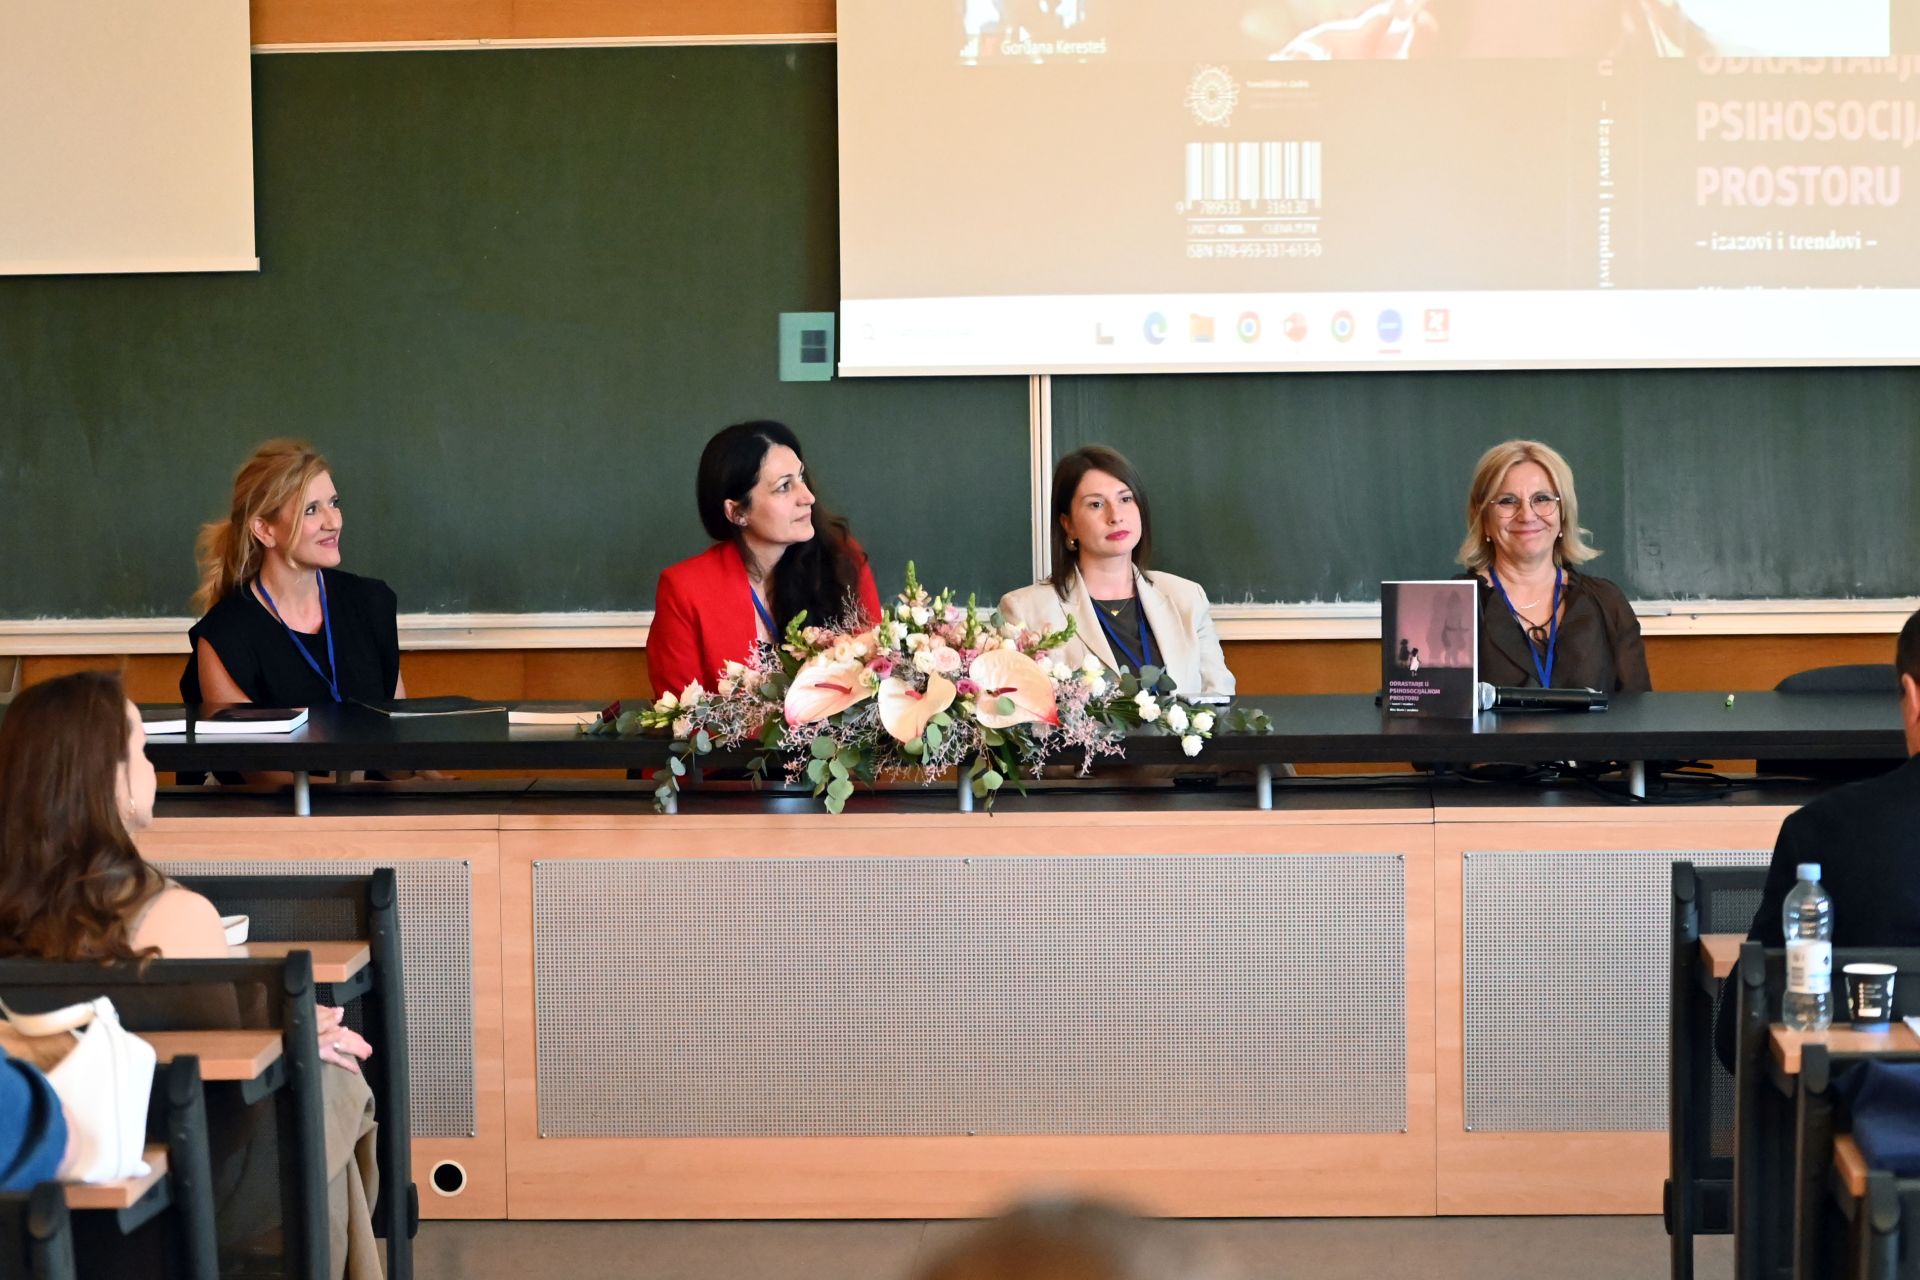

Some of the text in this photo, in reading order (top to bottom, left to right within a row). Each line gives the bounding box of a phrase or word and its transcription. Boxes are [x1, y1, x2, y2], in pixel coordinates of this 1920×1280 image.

[1696, 165, 1901, 207] PROSTORU
[1711, 231, 1772, 250] izazovi
[1777, 231, 1784, 250] i
[1789, 229, 1862, 250] trendovi
